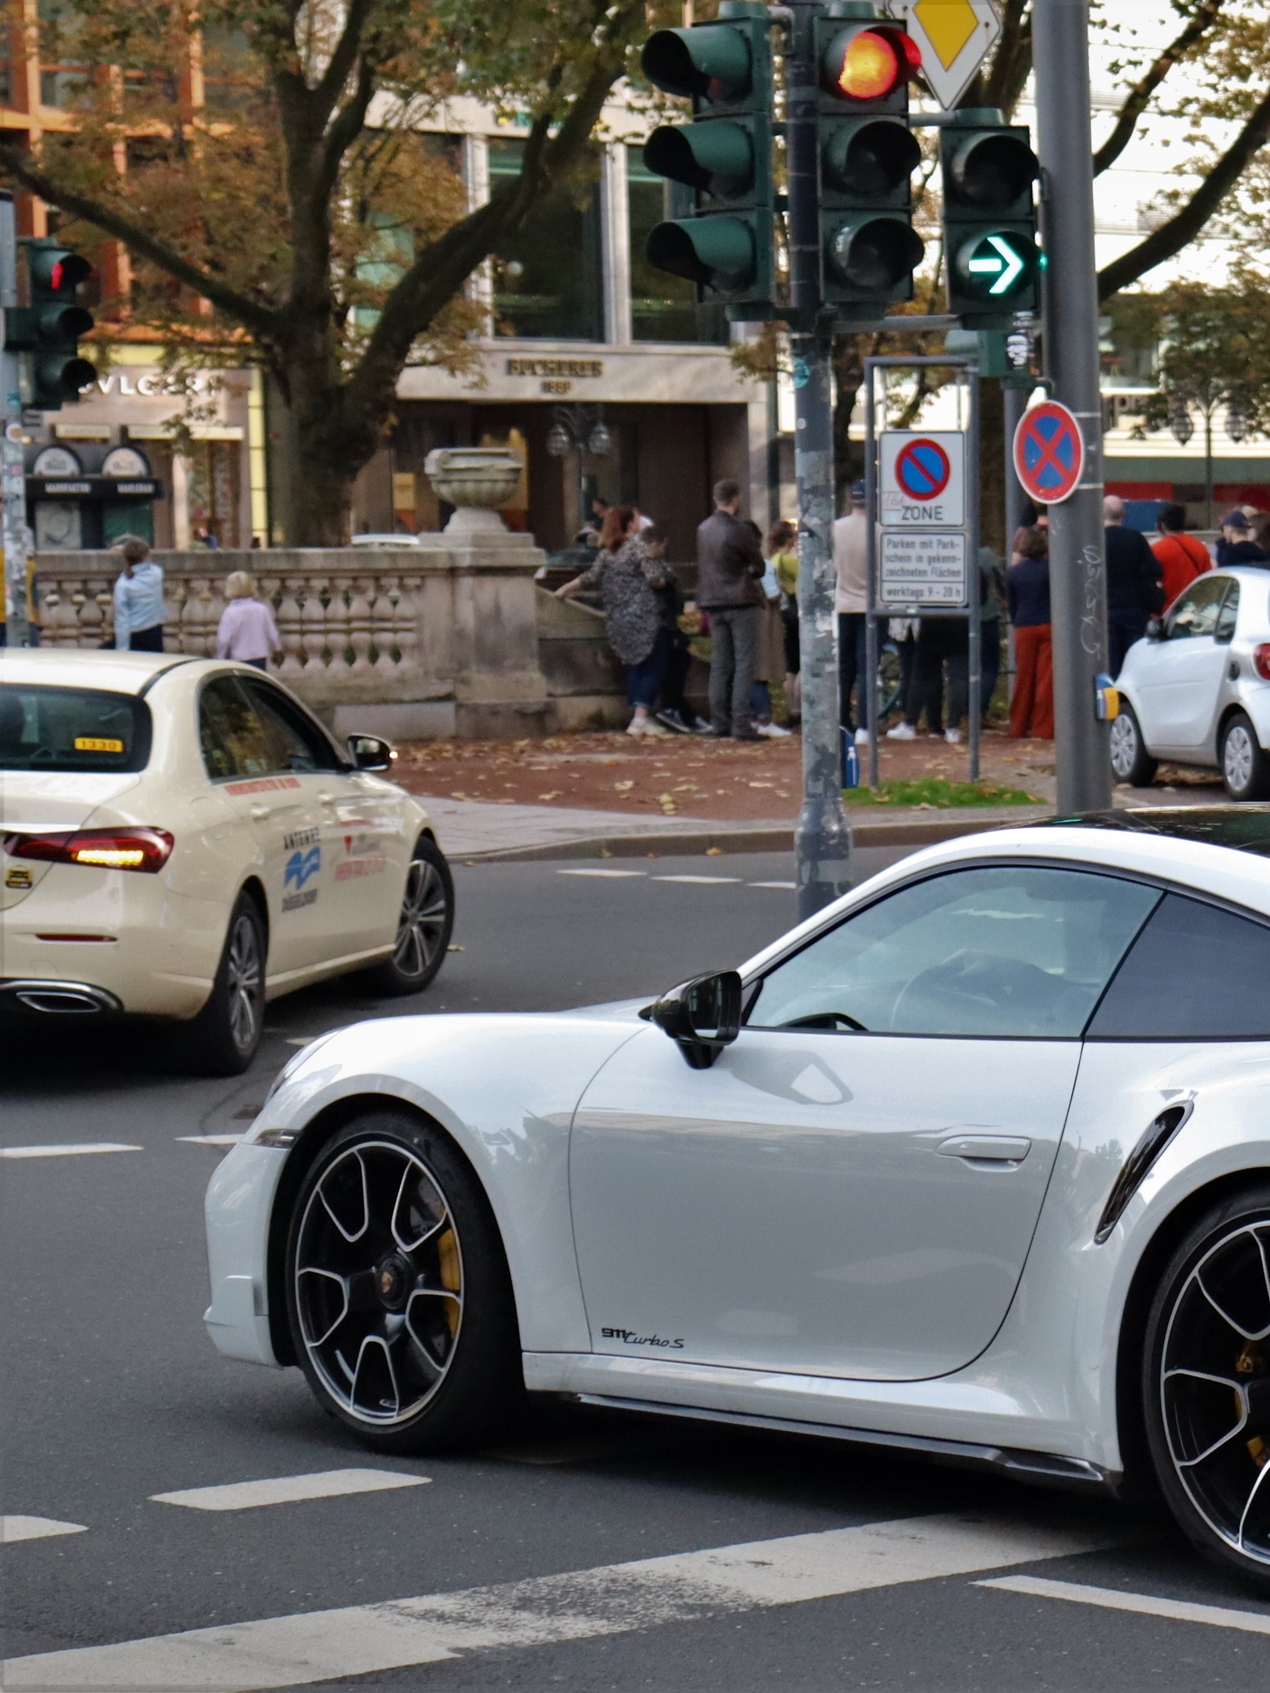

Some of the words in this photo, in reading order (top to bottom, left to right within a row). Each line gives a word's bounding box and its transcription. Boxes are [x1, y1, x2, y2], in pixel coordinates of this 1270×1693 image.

[902, 505, 944, 521] ZONE
[886, 539, 916, 549] Parken
[919, 539, 933, 549] mit
[936, 539, 960, 549] Park-
[885, 553, 912, 563] schein
[916, 554, 924, 563] in
[927, 554, 962, 566] gekenn-
[886, 568, 928, 577] zeichneten
[931, 566, 961, 577] Flächen
[886, 587, 924, 599] werktags
[928, 587, 933, 597] 9
[943, 587, 953, 597] 20
[956, 587, 961, 597] h
